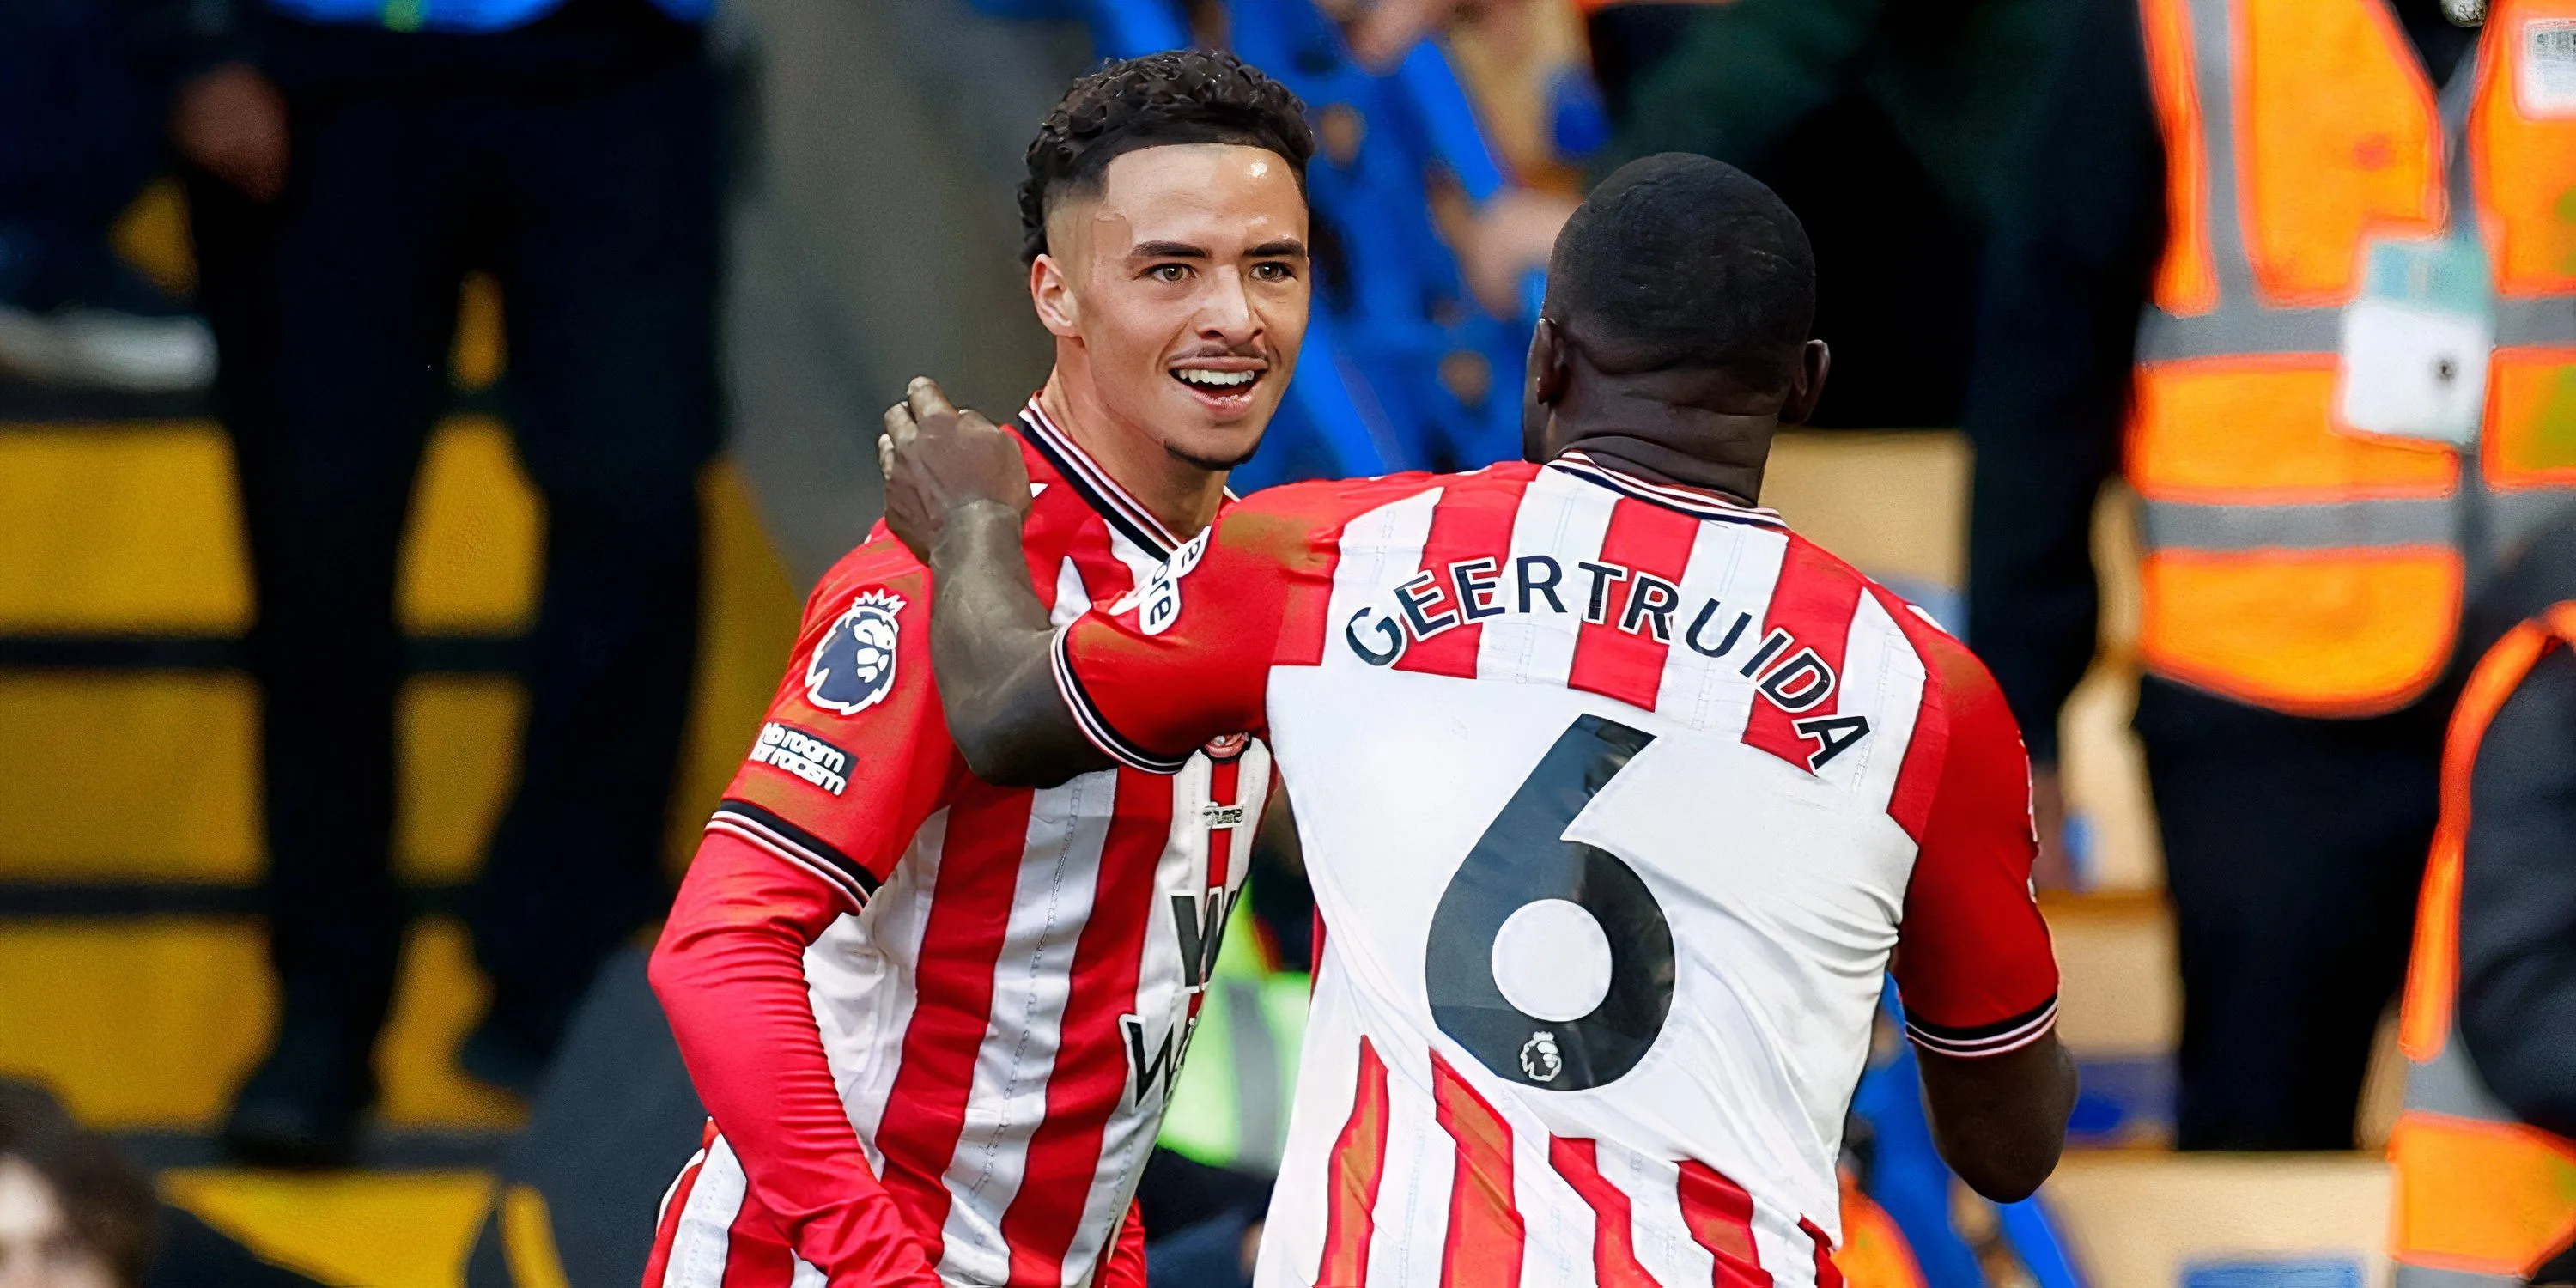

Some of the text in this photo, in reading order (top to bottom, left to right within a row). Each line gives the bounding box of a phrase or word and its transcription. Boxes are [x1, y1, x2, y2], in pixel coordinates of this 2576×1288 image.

[781, 730, 846, 774] room
[1346, 555, 1871, 772] GEERTRUIDA
[1425, 713, 1676, 1091] 6
